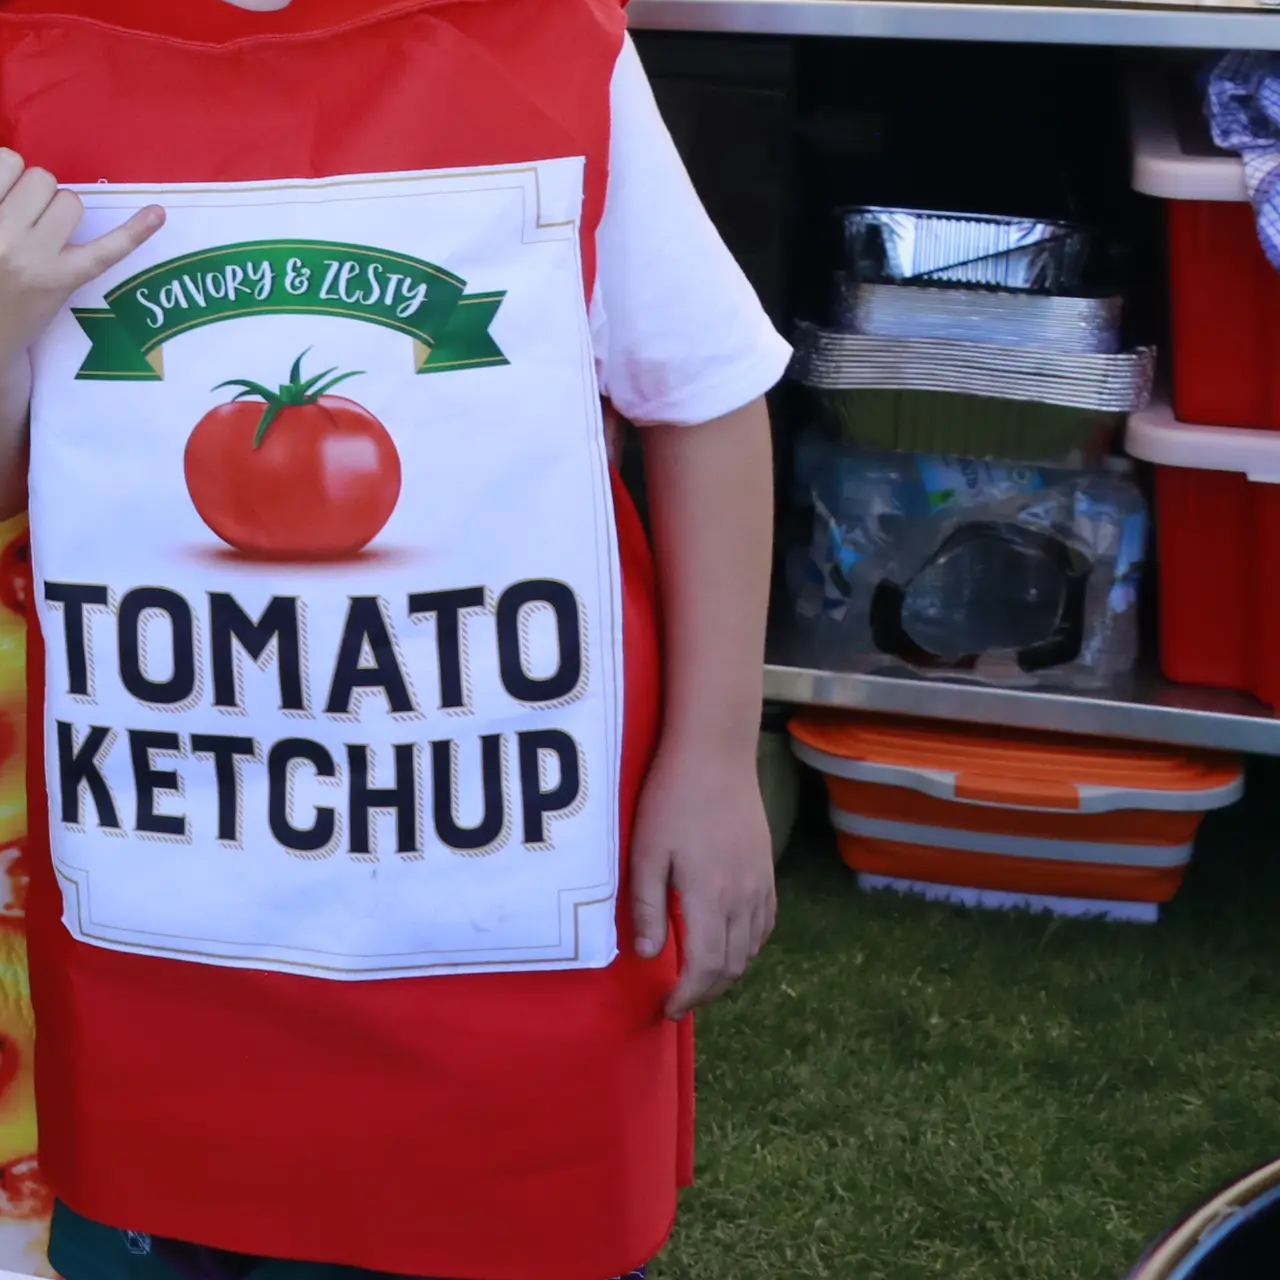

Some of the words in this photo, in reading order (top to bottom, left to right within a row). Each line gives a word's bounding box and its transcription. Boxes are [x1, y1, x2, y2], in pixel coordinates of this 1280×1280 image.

[284, 257, 311, 294] &
[43, 577, 591, 723] TOMATO
[56, 719, 589, 864] KETCHUP
